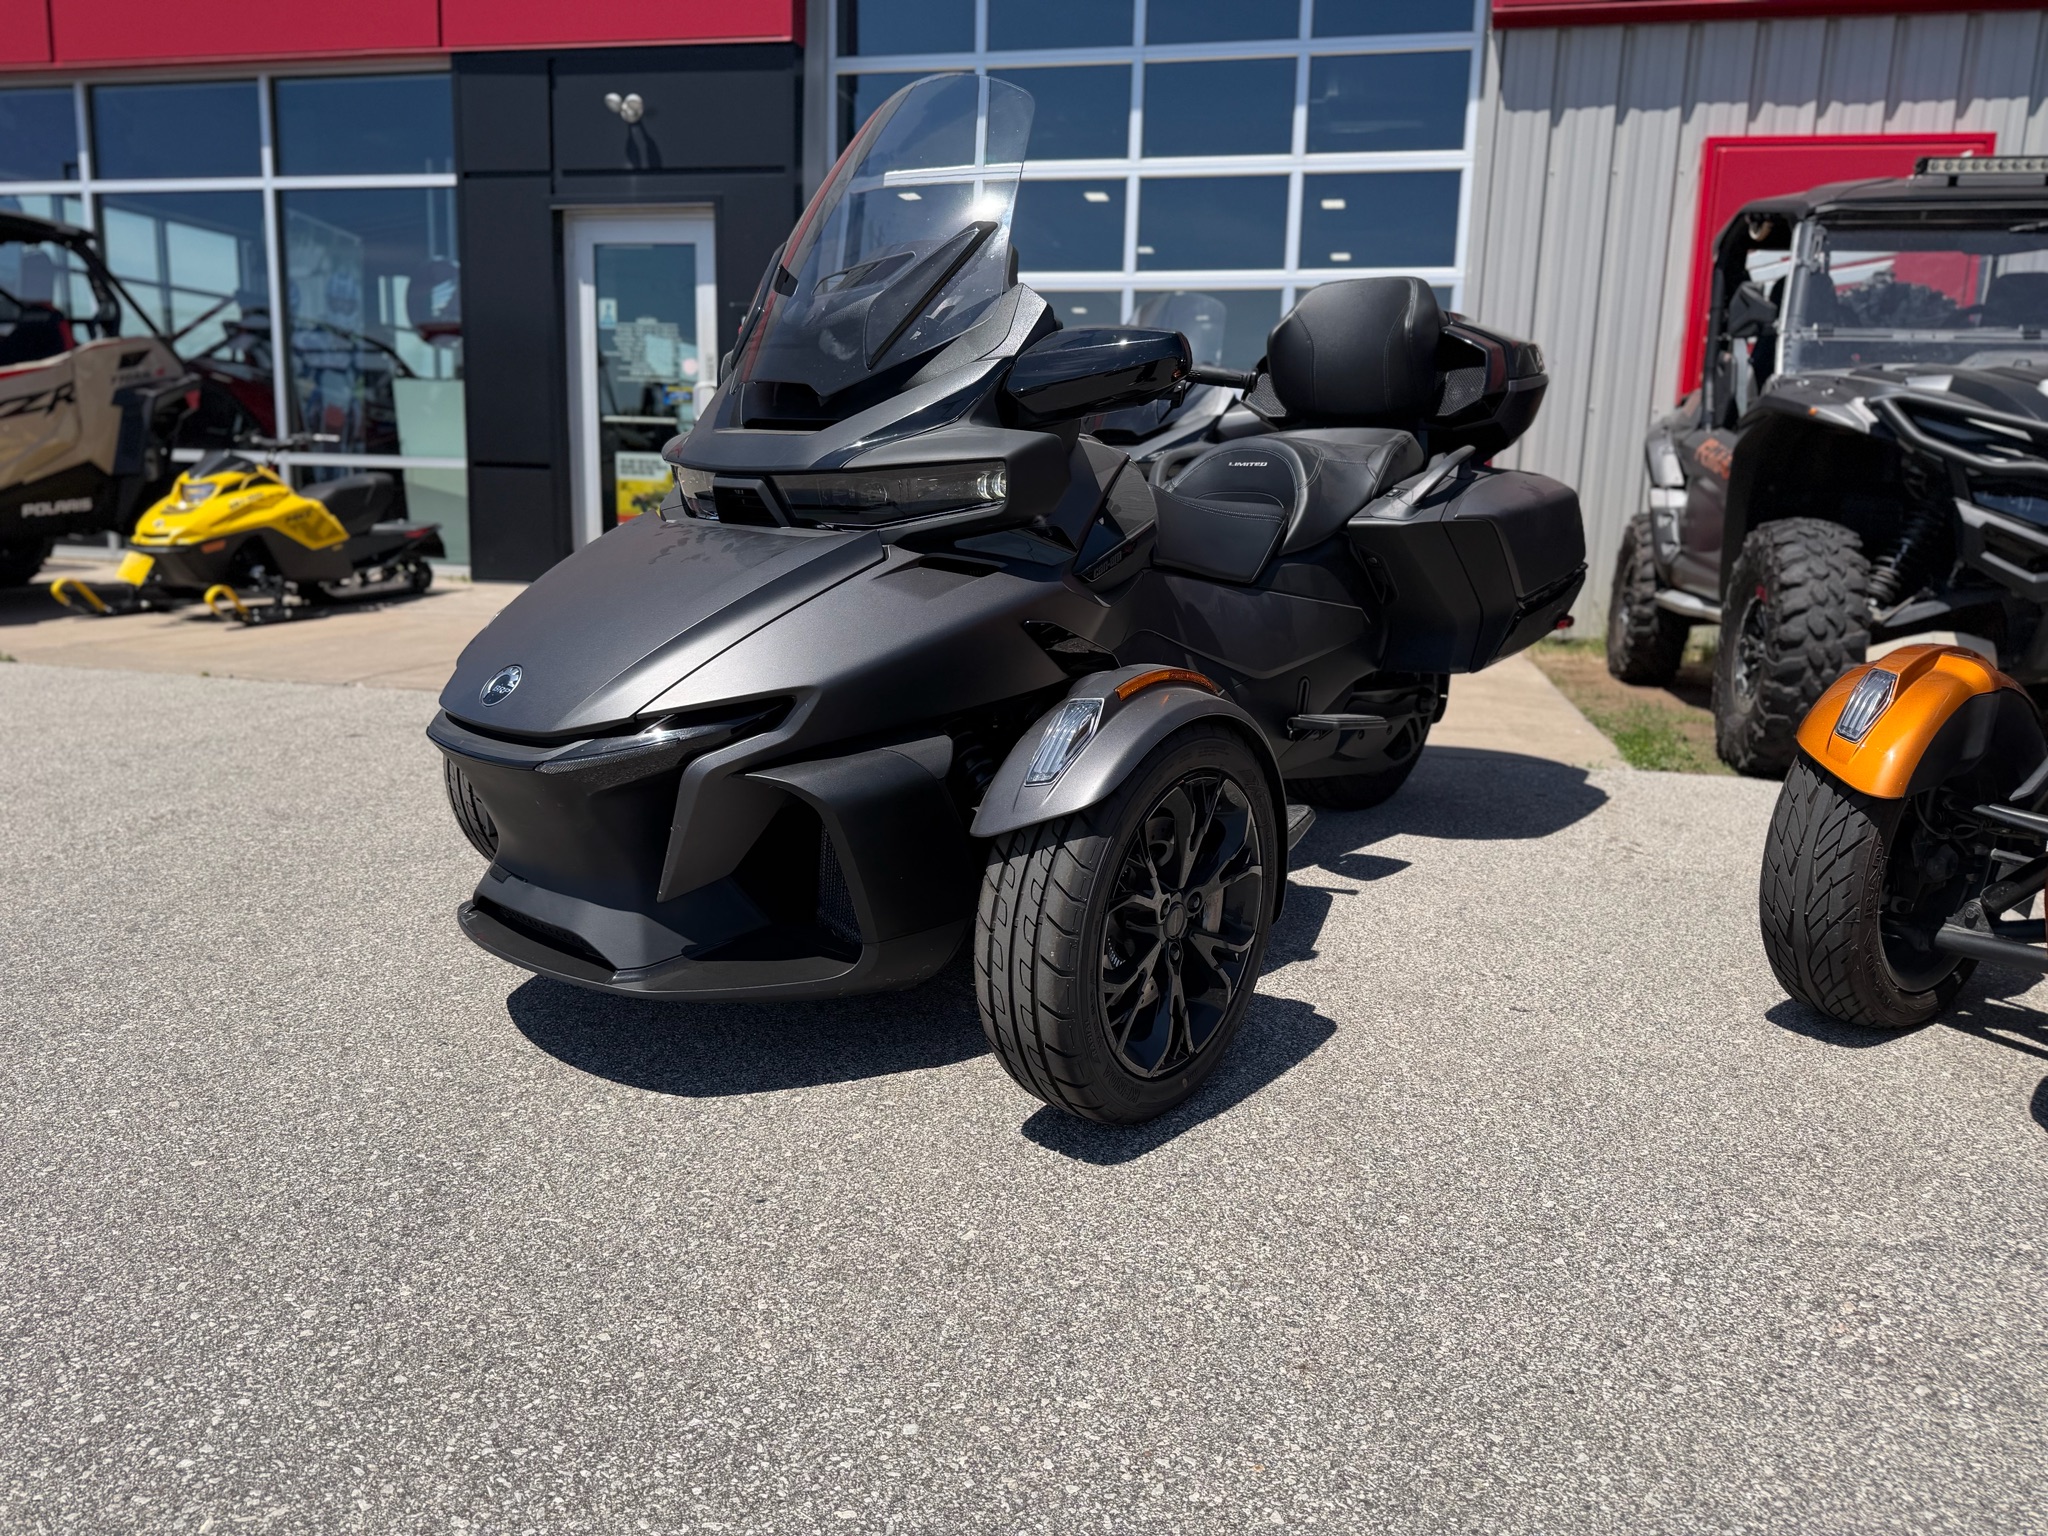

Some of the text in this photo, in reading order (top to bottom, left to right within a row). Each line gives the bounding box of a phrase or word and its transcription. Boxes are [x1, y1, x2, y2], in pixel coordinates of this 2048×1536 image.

[21, 497, 93, 518] POLARIS
[1093, 550, 1122, 578] can-am
[1085, 1018, 1099, 1058] RADIAL
[1102, 1062, 1142, 1104] KENDA
